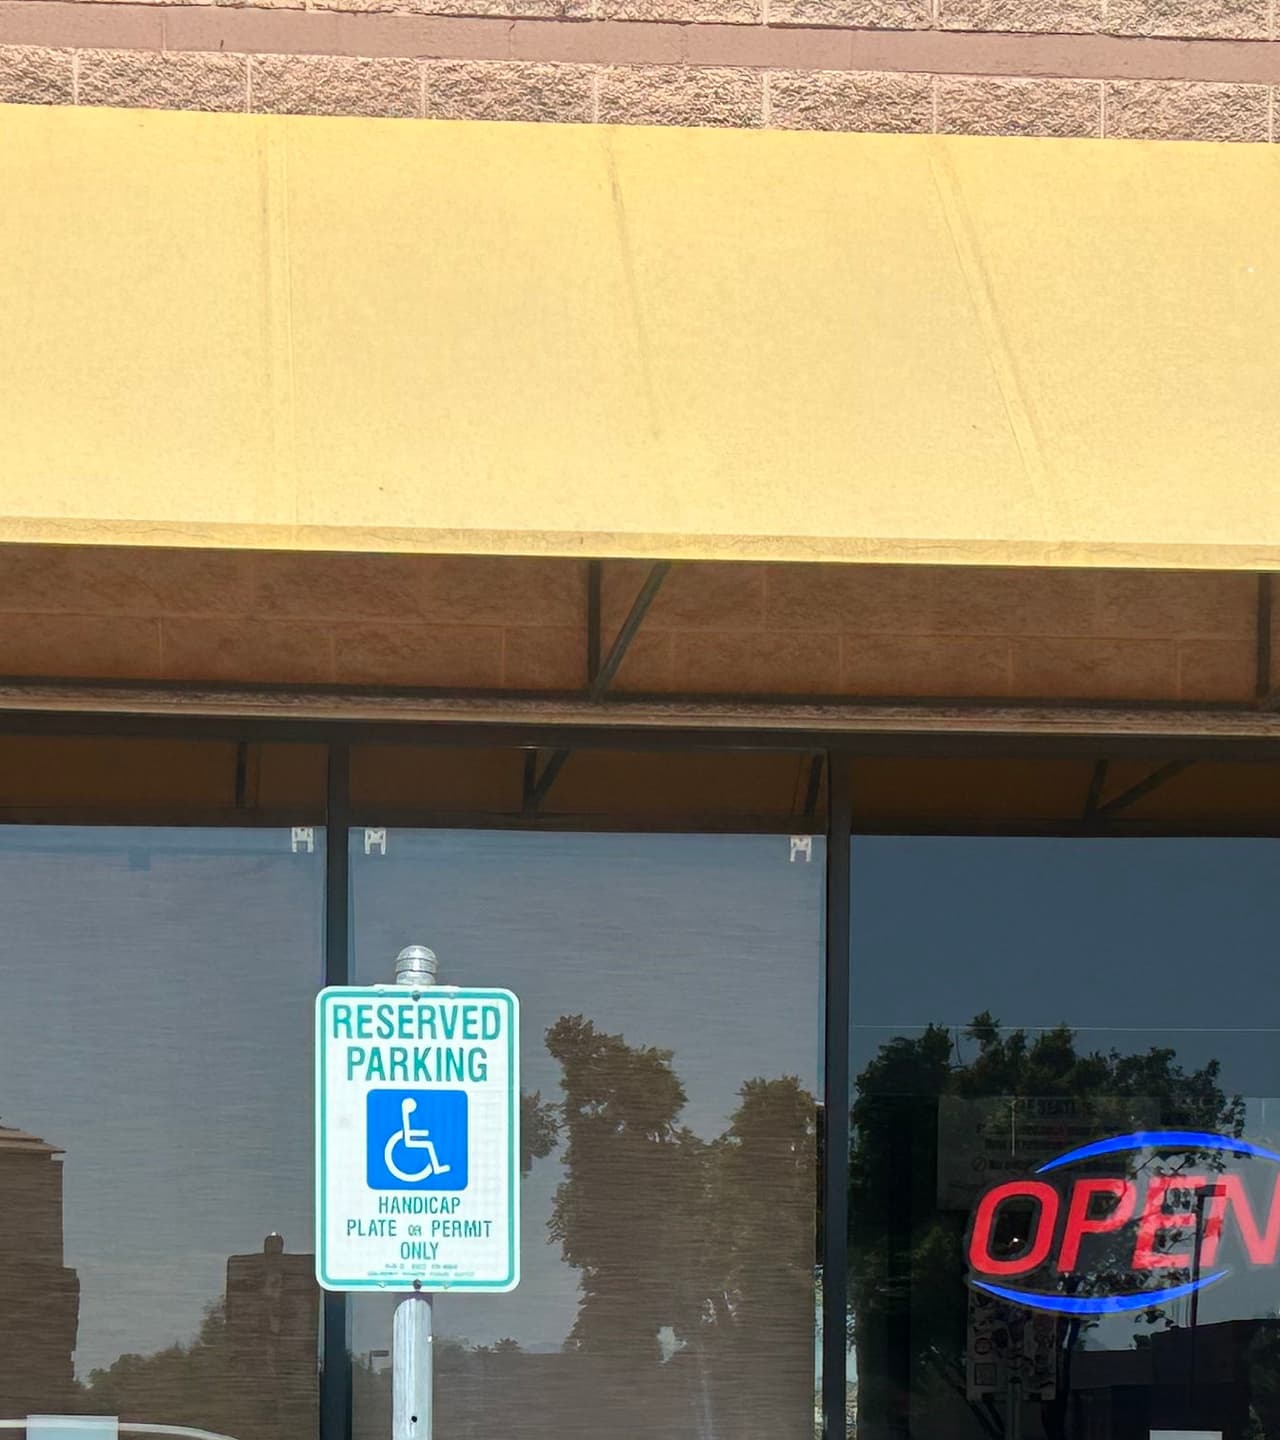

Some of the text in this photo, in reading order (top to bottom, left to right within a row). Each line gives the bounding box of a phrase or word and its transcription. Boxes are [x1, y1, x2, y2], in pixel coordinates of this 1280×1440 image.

[333, 1004, 501, 1041] RESERVED
[347, 1047, 488, 1082] PARKING
[378, 1196, 461, 1214] HANDICAP
[347, 1219, 397, 1237] PLATE
[432, 1219, 493, 1238] PERMIT
[400, 1242, 439, 1260] ONLY
